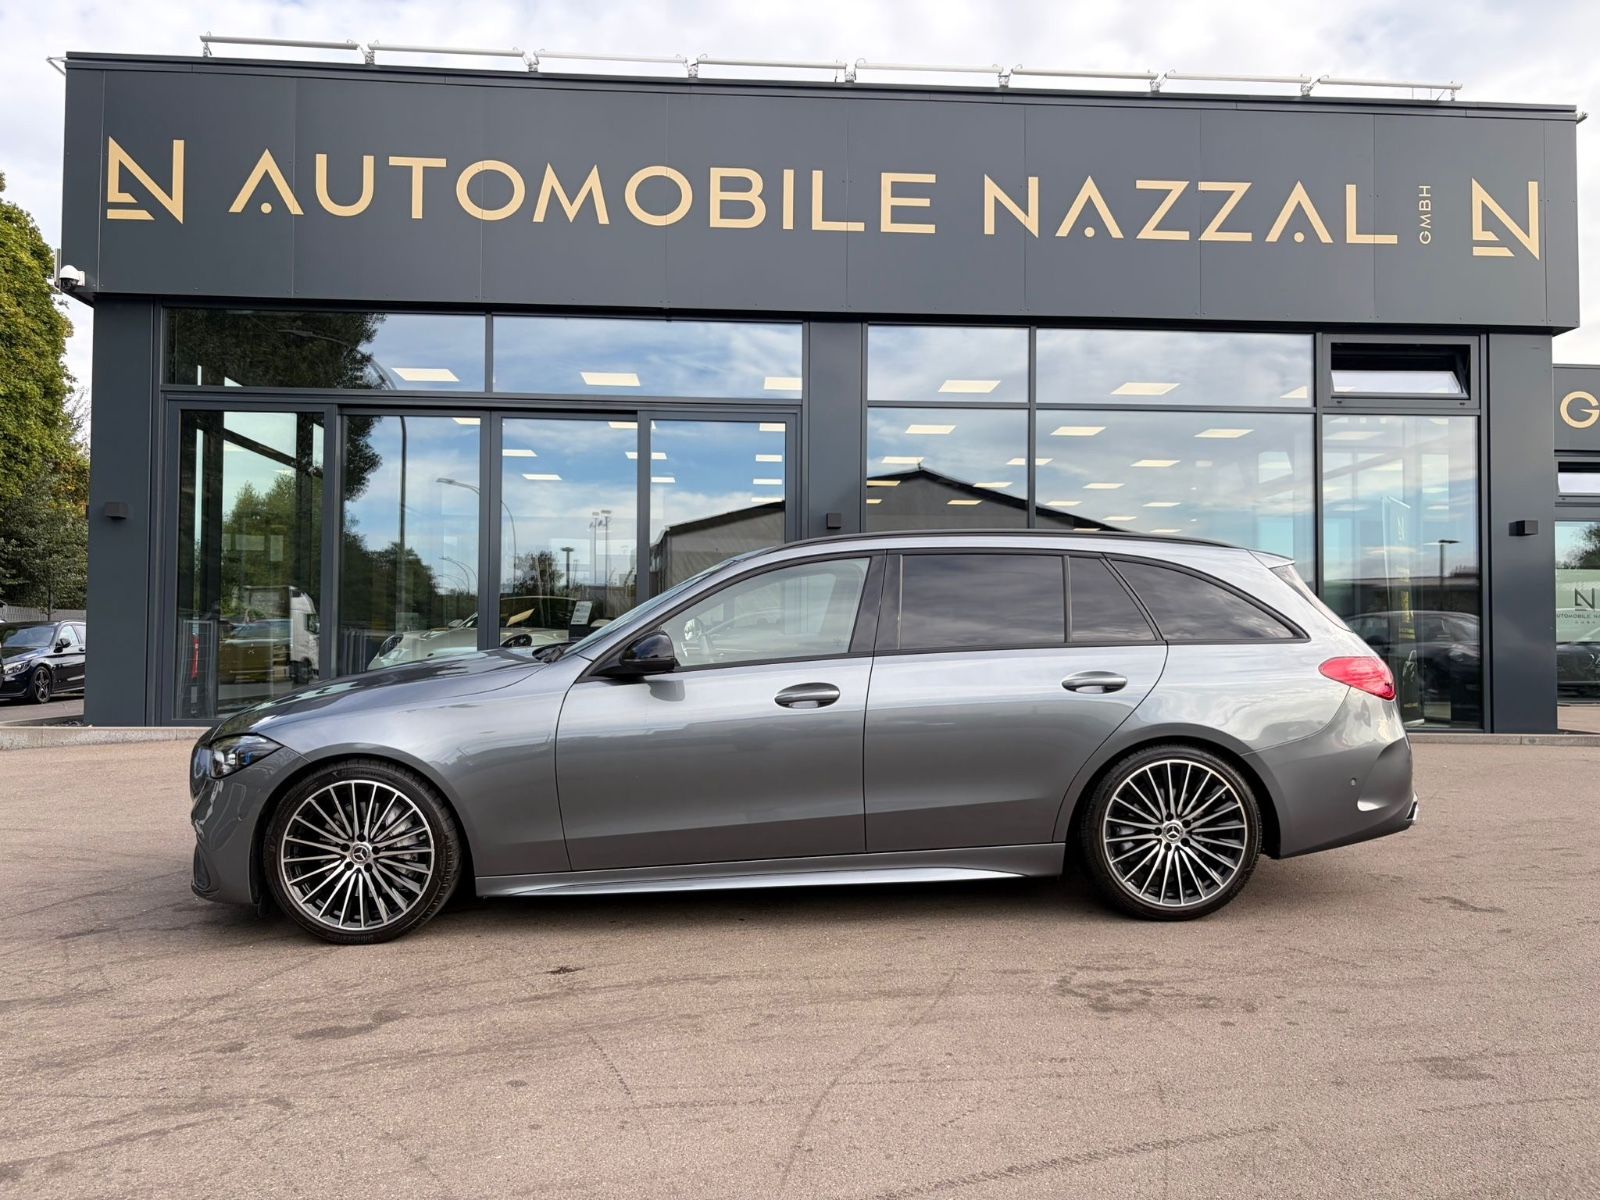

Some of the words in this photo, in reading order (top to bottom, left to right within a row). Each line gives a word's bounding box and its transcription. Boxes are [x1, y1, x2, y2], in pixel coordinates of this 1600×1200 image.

[228, 148, 938, 236] AUTOMOBILE
[983, 175, 1399, 246] NAZZAL
[1418, 185, 1432, 245] GMBH
